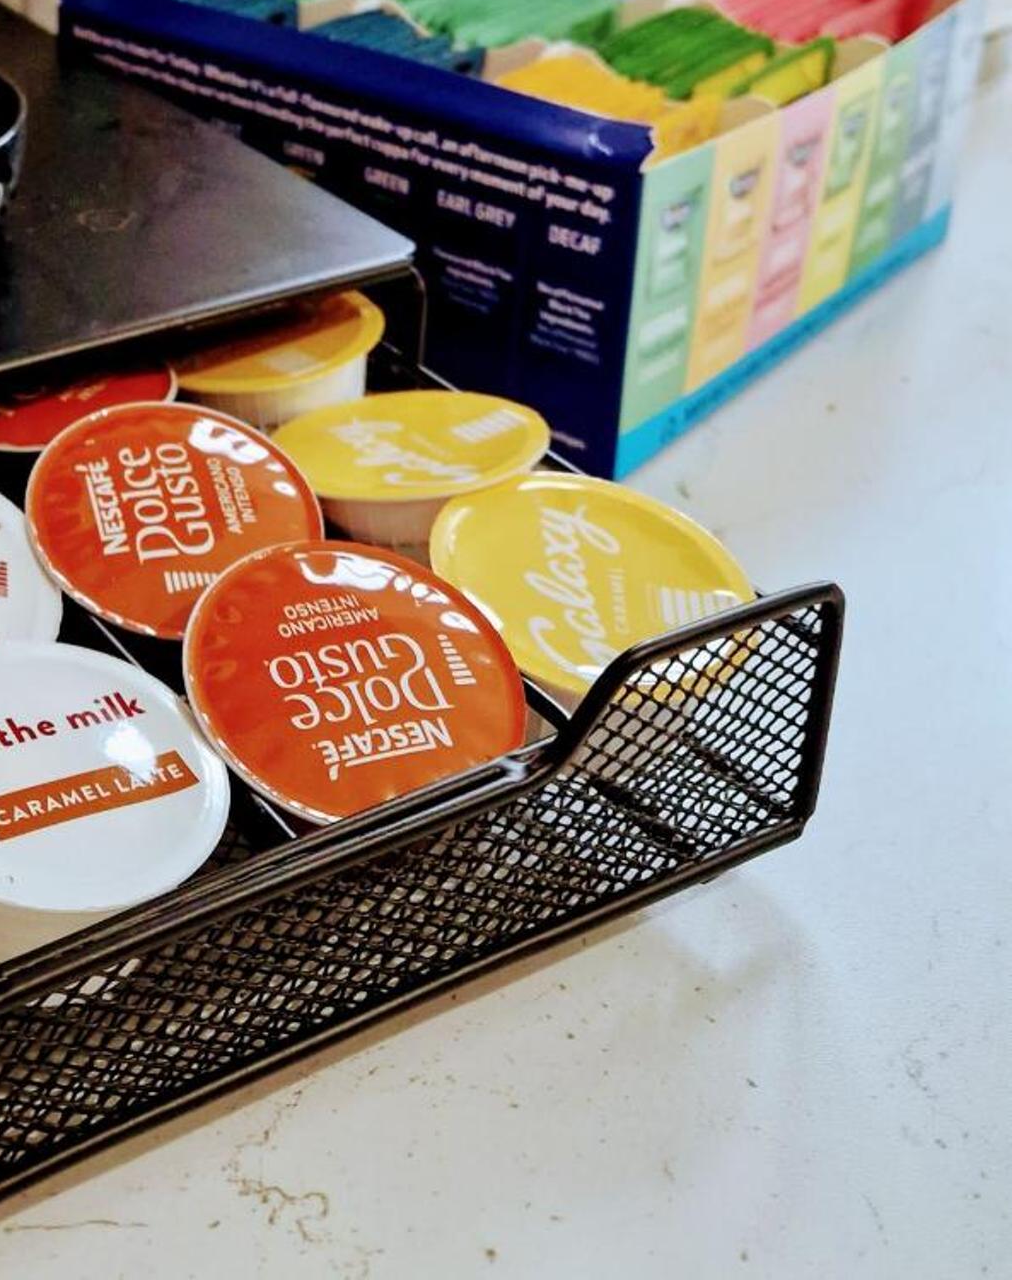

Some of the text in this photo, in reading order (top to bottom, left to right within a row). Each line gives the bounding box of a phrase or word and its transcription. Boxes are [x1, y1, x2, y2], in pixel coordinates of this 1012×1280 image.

[437, 189, 516, 229] EARL GREY
[548, 223, 602, 256] DECAF
[75, 458, 130, 555] NESCAFÉ
[119, 447, 180, 564] Dolce
[157, 442, 216, 556] Gusto
[278, 607, 380, 638] AMERICANO
[284, 594, 359, 620] INTENSO
[267, 632, 426, 689] Gusto
[65, 691, 146, 730] milk
[284, 666, 456, 730] Dolce
[316, 716, 454, 781] NESCAFÉ
